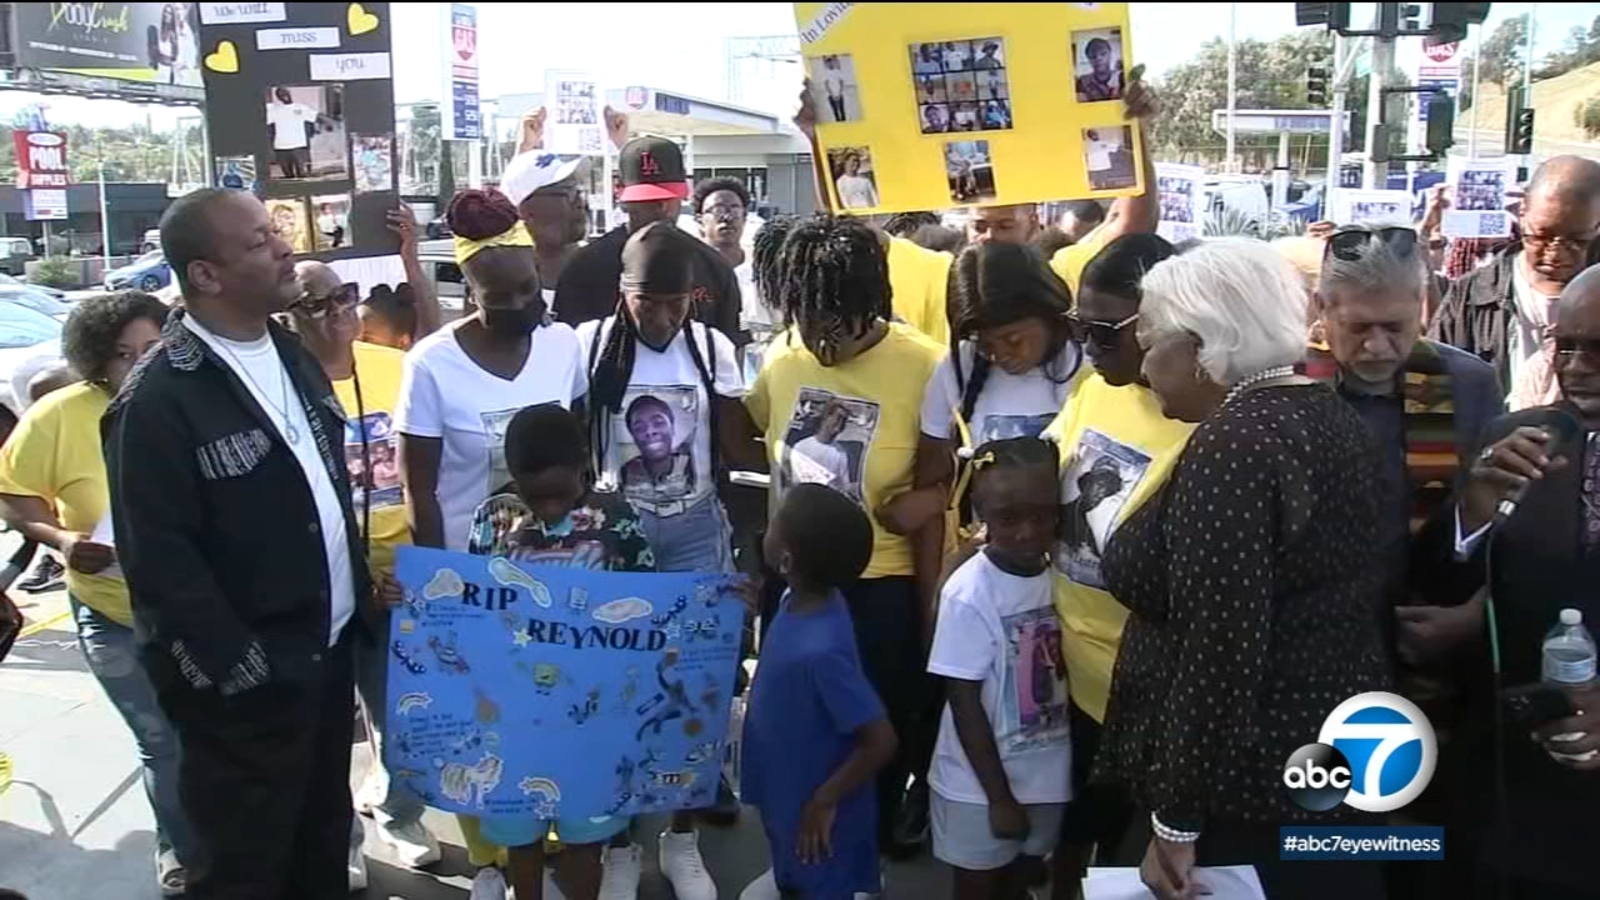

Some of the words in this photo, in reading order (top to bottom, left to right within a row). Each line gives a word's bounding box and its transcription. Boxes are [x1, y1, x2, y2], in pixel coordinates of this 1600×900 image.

[280, 33, 317, 44] miss
[801, 28, 819, 44] In
[336, 58, 365, 73] you
[29, 146, 66, 171] POOL
[641, 151, 661, 175] LA
[460, 582, 518, 610] RIP
[527, 618, 668, 651] REYNOLD
